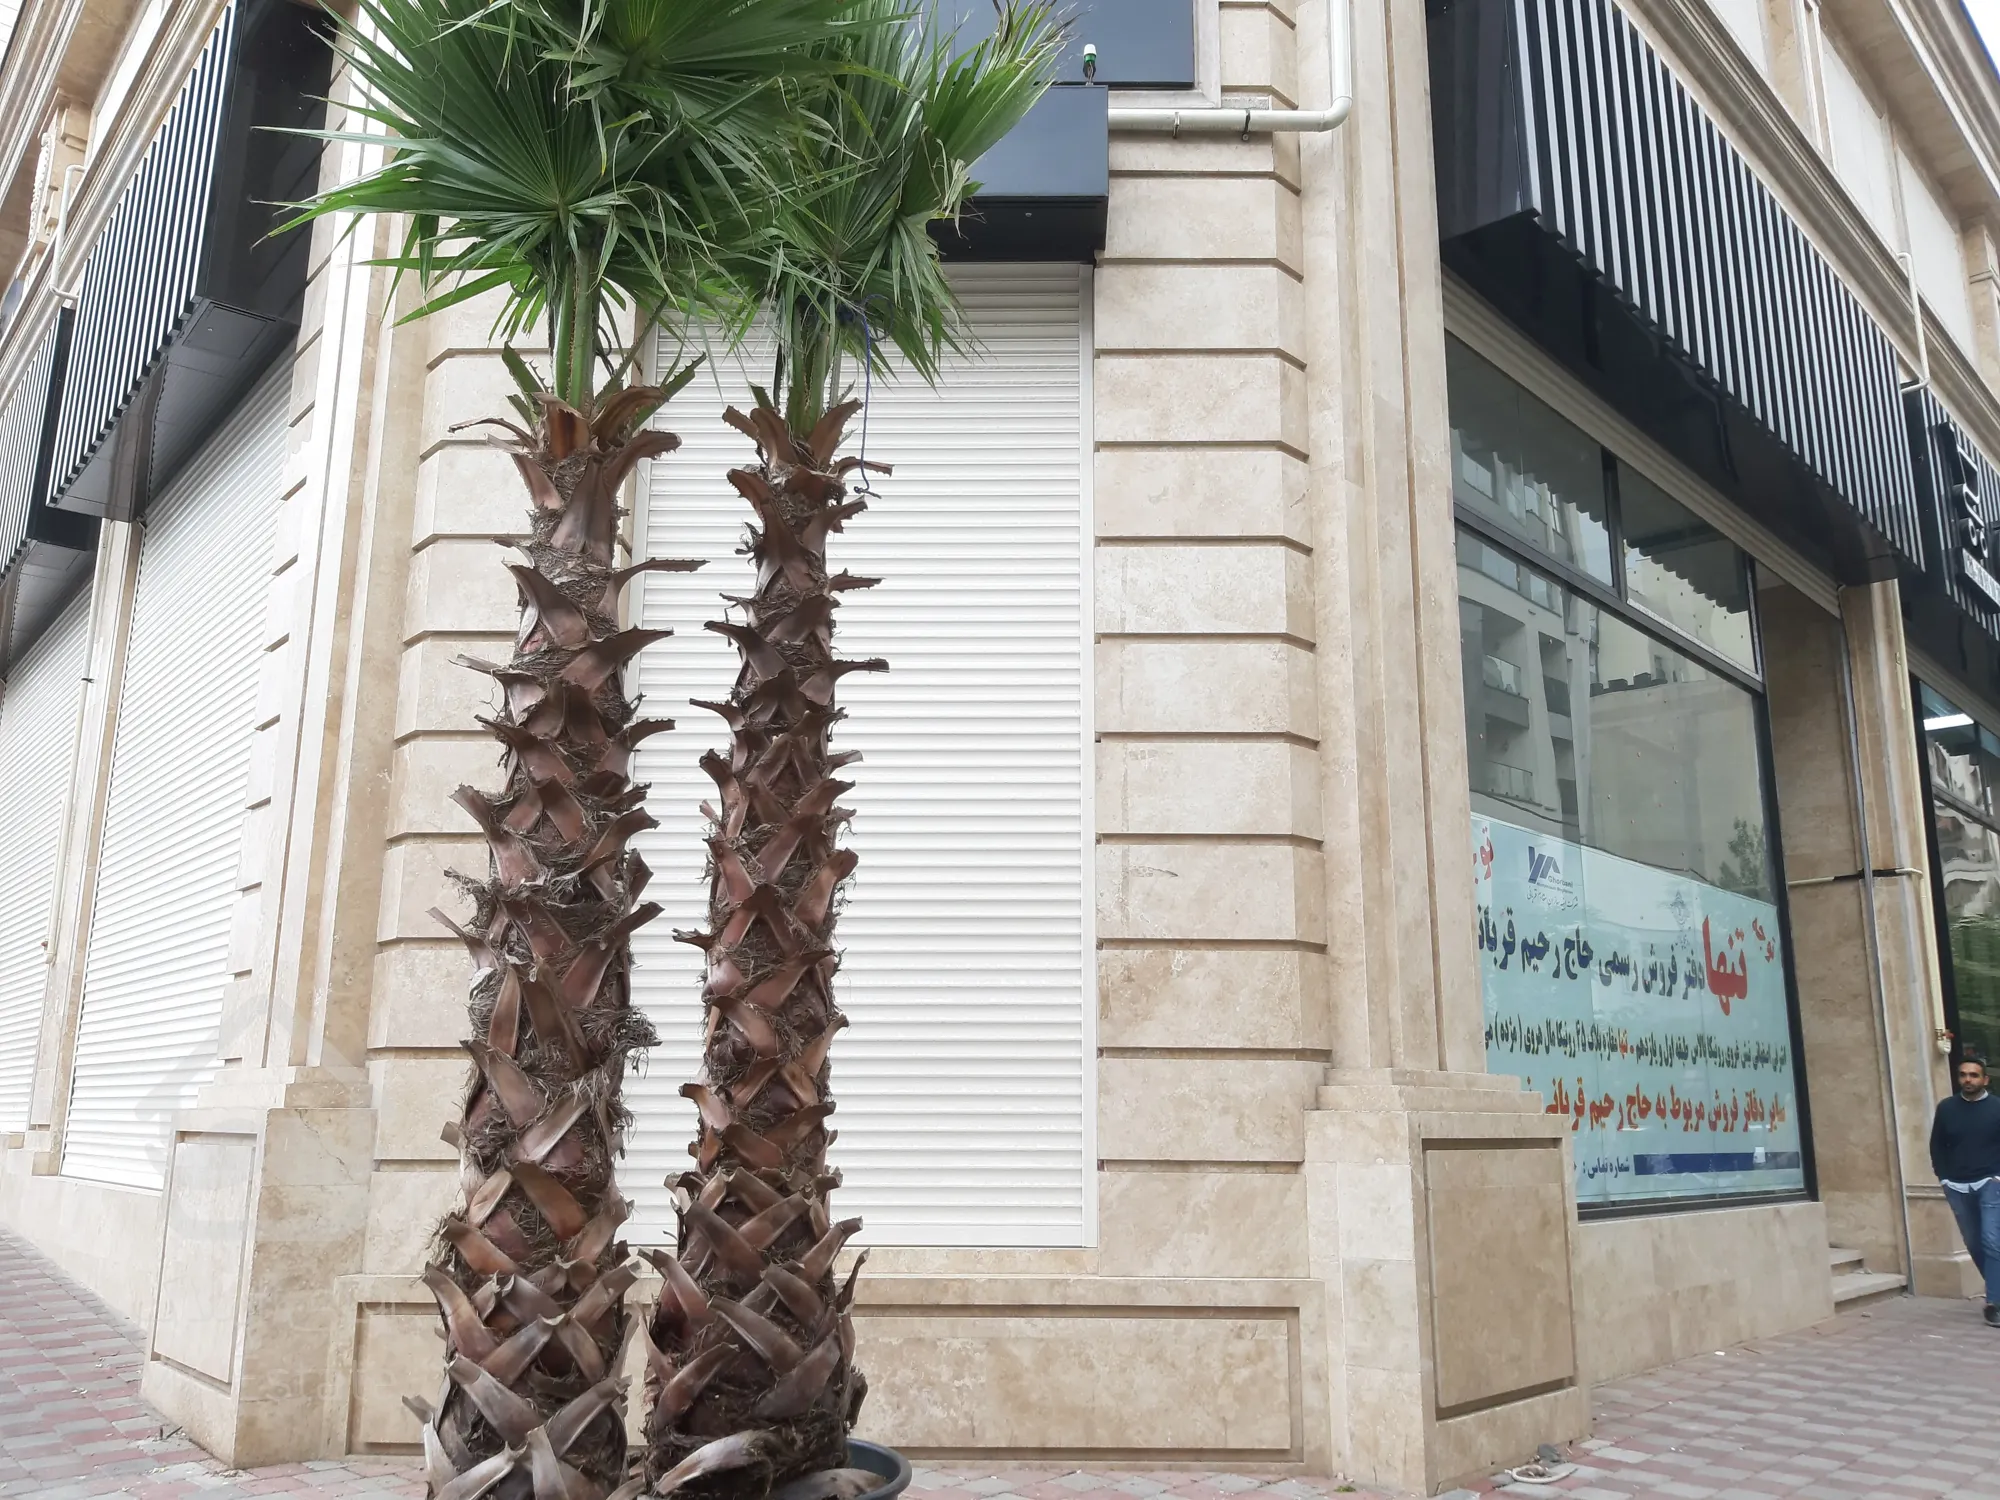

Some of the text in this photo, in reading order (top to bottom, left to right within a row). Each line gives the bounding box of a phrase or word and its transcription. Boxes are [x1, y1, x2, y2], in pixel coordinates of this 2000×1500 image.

[1472, 826, 1494, 885] تو
[1478, 904, 1748, 1016] تنها دفتر فروش رسمی حاج رحیم قربان
[1618, 1027, 1628, 1060] تنها
[1589, 1093, 1624, 1131] رحیم
[1626, 1082, 1652, 1129] حاج
[1655, 1092, 1667, 1130] به
[1670, 1084, 1705, 1132] مربوط
[1707, 1087, 1739, 1133] فروش
[1743, 1087, 1765, 1133] دفاتر
[1609, 1157, 1630, 1179] شماره
